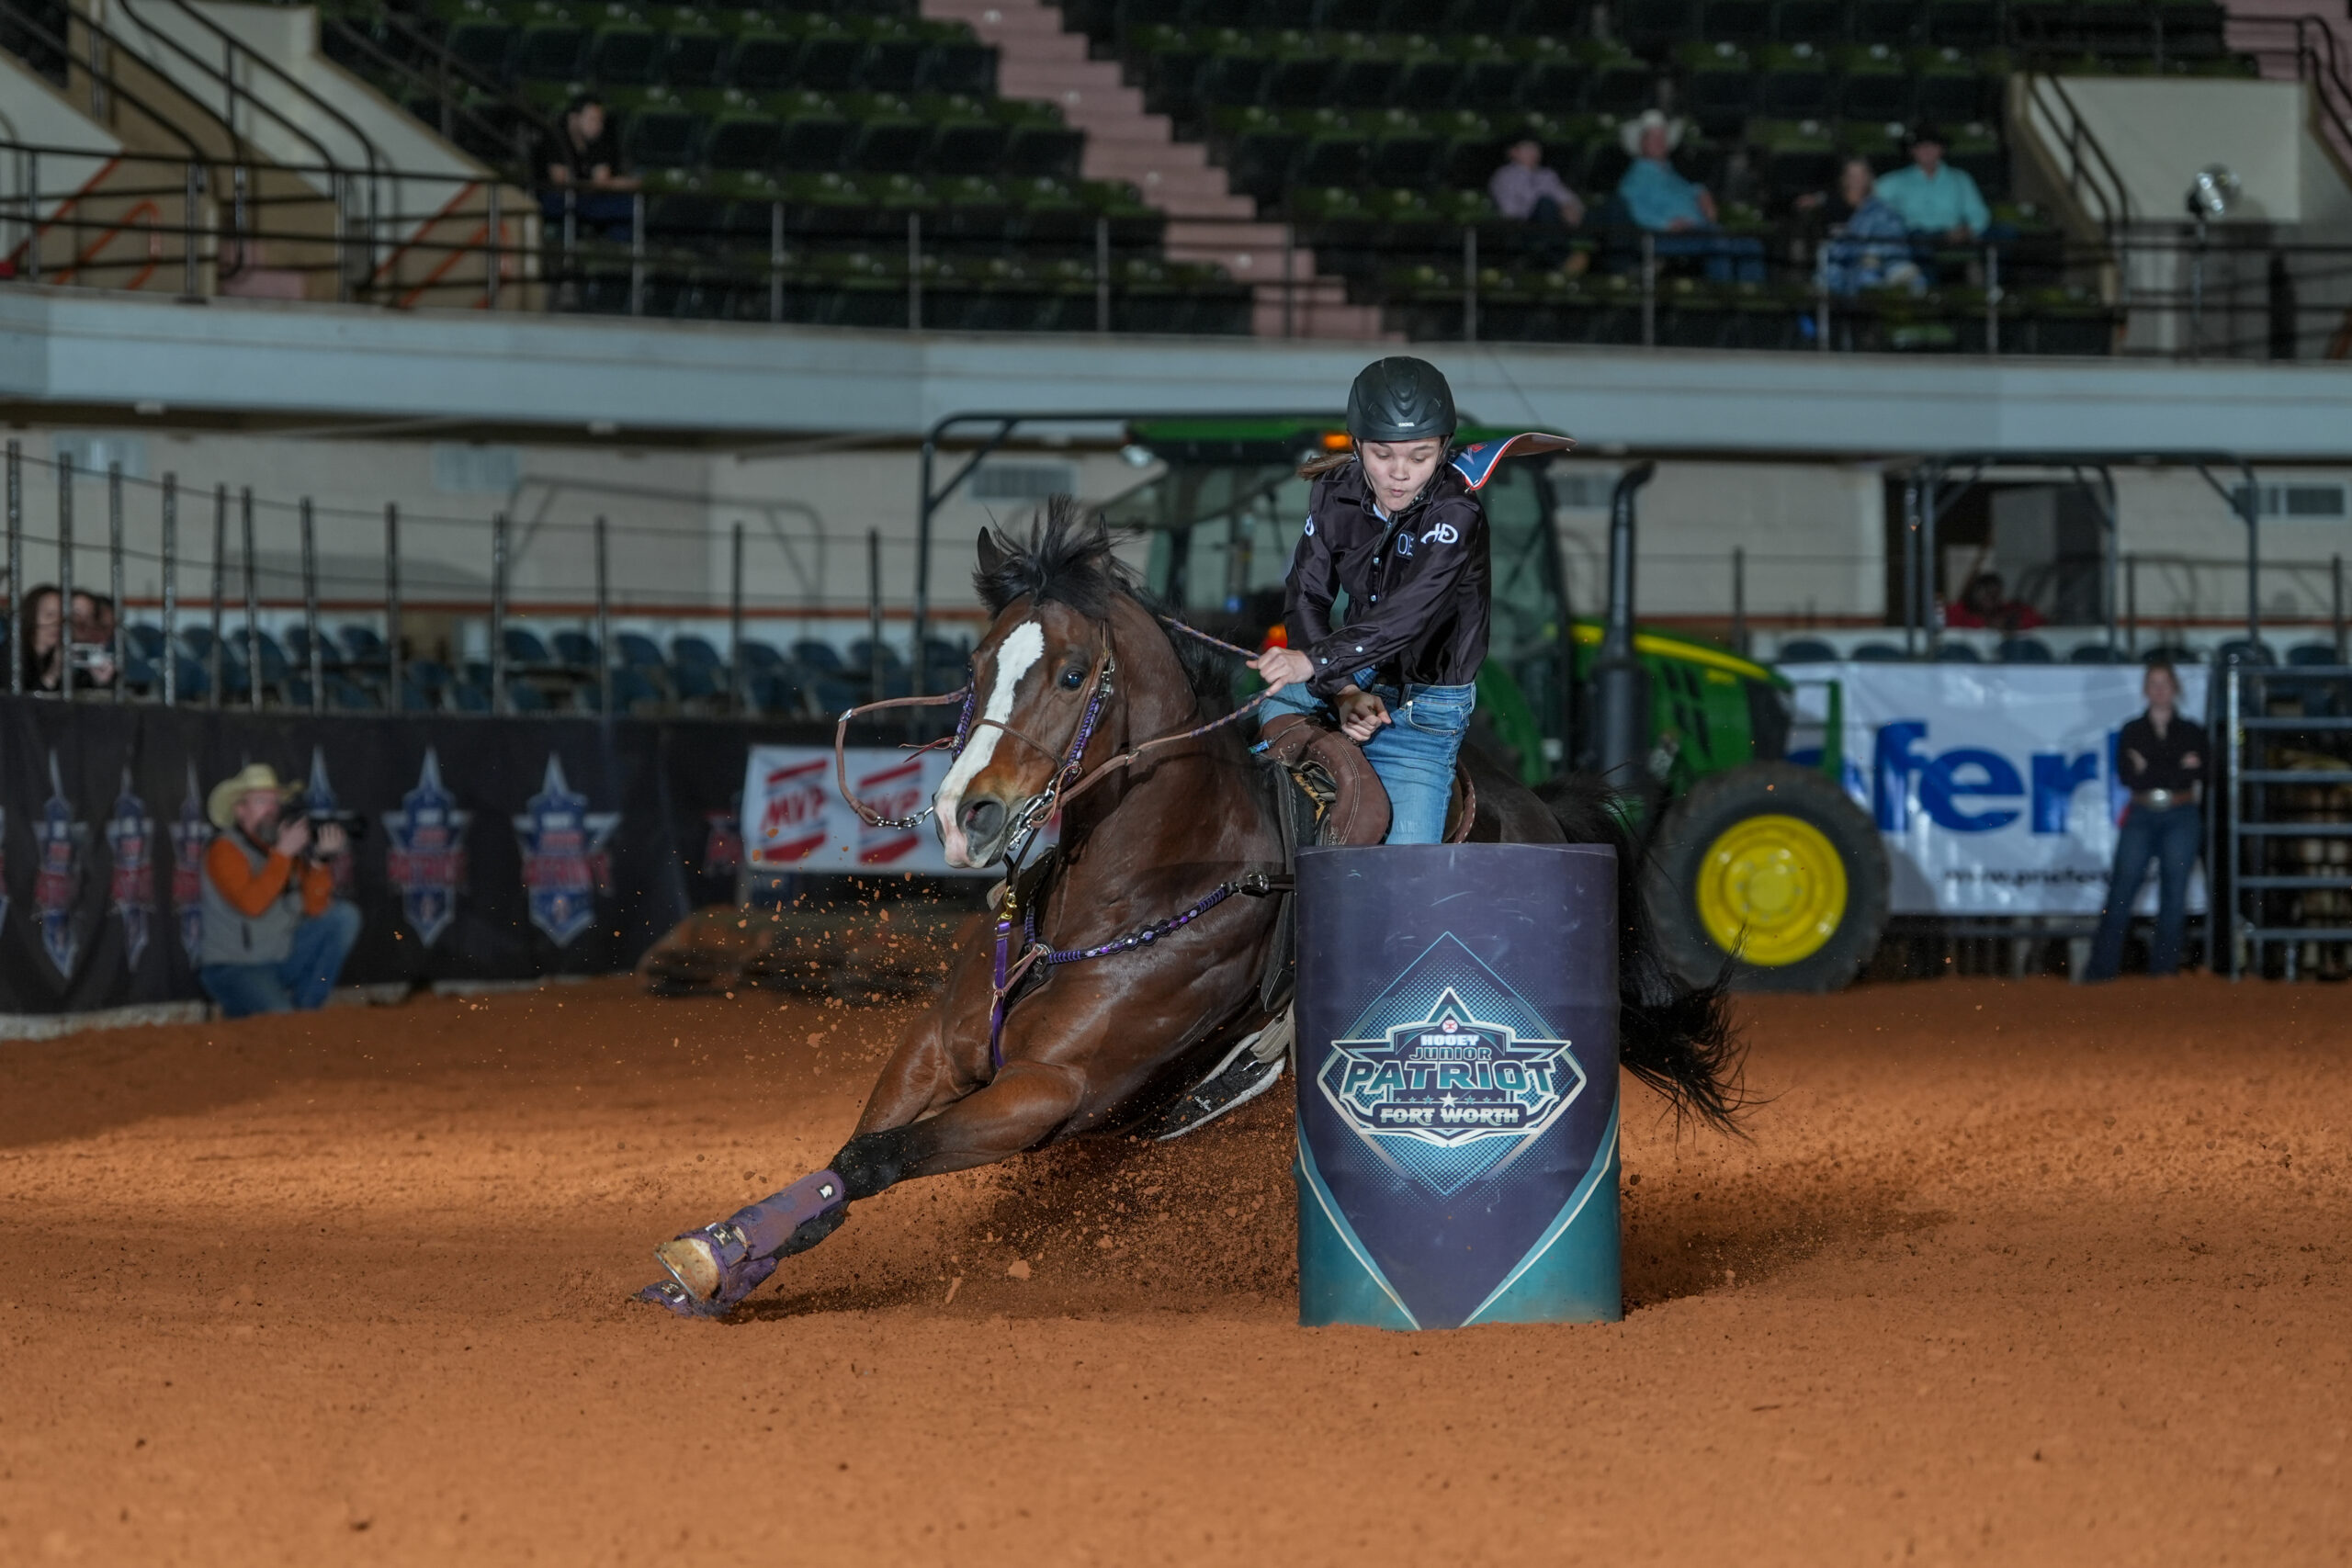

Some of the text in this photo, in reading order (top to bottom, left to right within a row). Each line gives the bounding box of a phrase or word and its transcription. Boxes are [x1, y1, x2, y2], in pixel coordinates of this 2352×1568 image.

[1420, 1034, 1479, 1046] HOOEY
[1409, 1046, 1492, 1061] JUNIOR
[1341, 1059, 1555, 1095] PATRIOT
[1380, 1108, 1519, 1126] FORT WORTH
